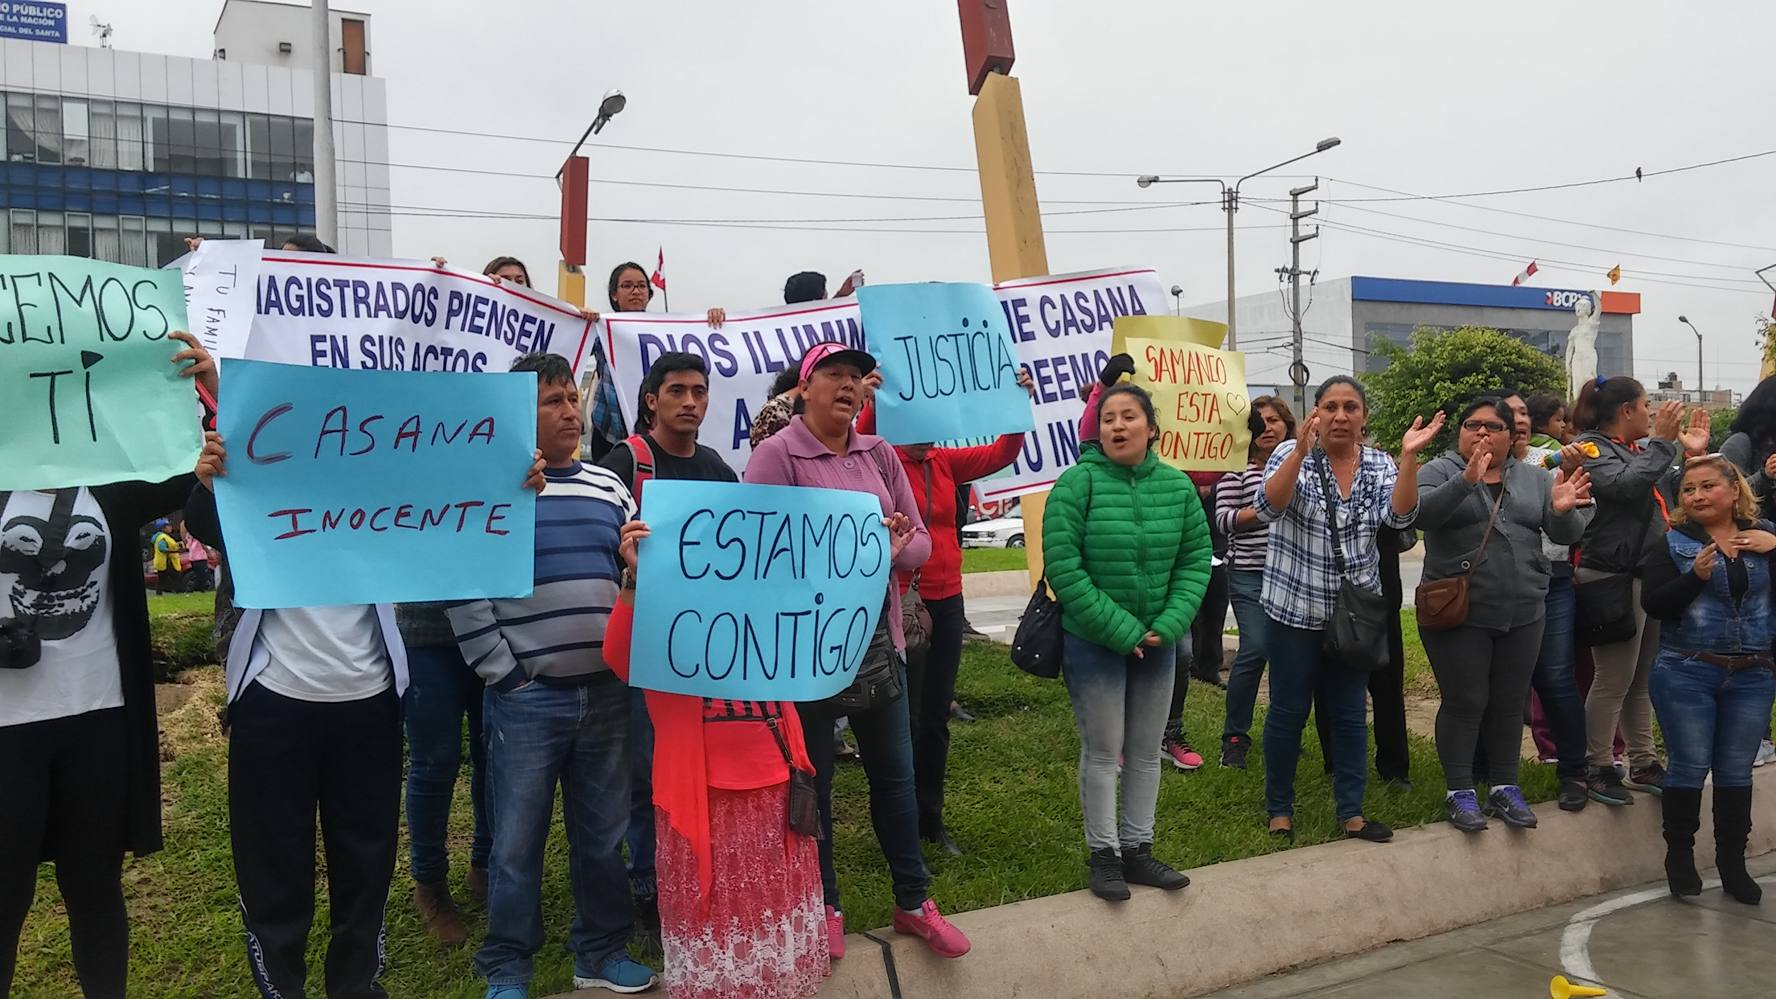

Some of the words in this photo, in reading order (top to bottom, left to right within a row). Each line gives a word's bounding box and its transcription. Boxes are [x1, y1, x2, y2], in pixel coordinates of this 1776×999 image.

[6, 15, 19, 23] LA
[20, 16, 55, 26] NACIÓN
[12, 3, 63, 19] PÚBLICO
[18, 27, 33, 35] DEL
[35, 29, 60, 37] SANTA
[256, 273, 438, 327] AGISTRADOS
[444, 291, 555, 353] PIENSEN
[1039, 284, 1147, 339] CASANA
[1552, 290, 1580, 308] BCP
[309, 334, 350, 369] EN
[359, 334, 406, 371] SUS
[1145, 344, 1228, 386] SAMANCO
[1176, 391, 1222, 425] ESTA
[246, 402, 496, 466] CASANA
[1160, 430, 1234, 461] ONTIGO
[267, 500, 512, 541] INOCENTE
[678, 508, 883, 581] ESTAMOS
